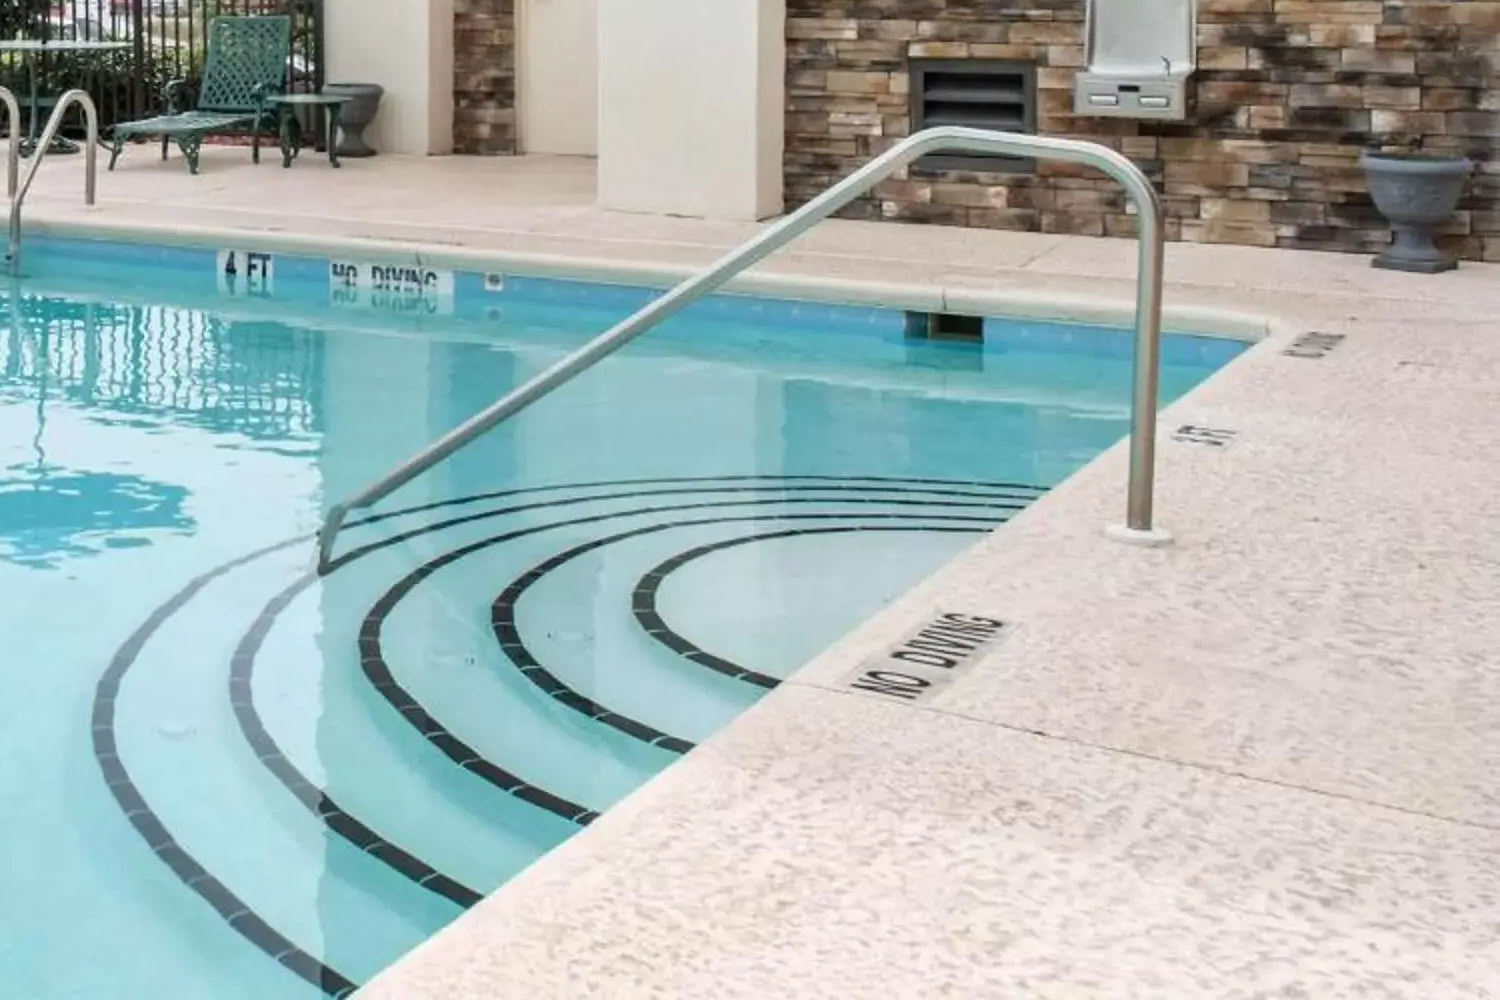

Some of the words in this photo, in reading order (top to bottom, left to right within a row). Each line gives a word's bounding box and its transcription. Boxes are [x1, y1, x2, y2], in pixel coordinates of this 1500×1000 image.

[247, 252, 272, 279] FT
[889, 612, 1004, 669] DIVING
[851, 670, 932, 700] NO
